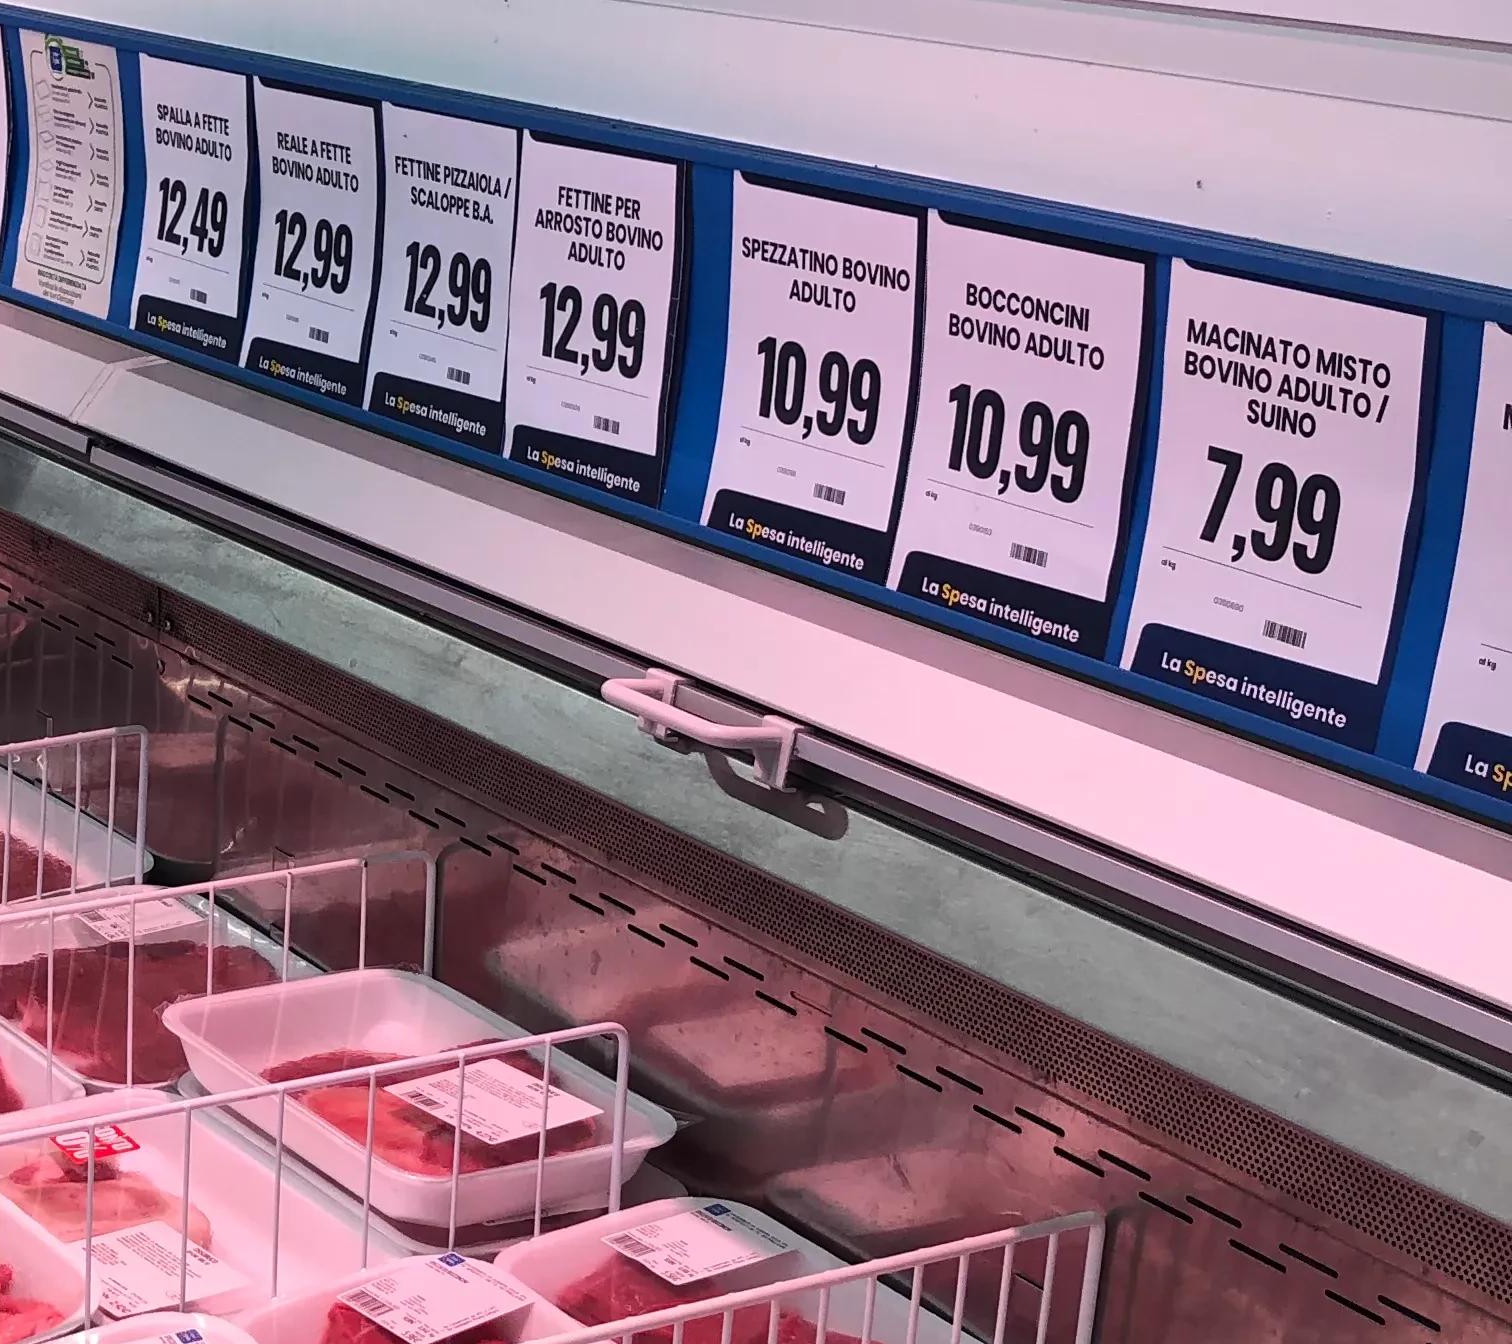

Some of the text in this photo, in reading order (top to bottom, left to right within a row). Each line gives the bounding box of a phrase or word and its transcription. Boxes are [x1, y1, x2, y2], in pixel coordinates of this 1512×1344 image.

[157, 104, 229, 136] SPALLA A FETTE
[156, 128, 232, 162] BOVINO ADULTO
[277, 132, 351, 164] REALE A FETTE
[272, 156, 358, 192] BOVINO ADULTO
[395, 156, 512, 199] FETTINE PIZZAIOLA /
[157, 177, 228, 258] 12,49
[410, 186, 494, 224] SCALOPPE B.A.
[558, 186, 641, 221] FETTINE PER
[274, 209, 353, 294] 12,99
[535, 209, 663, 252] ARROSTO BOVINO
[568, 242, 625, 271] ADULTO
[742, 236, 910, 292] SPEZZATINO BOVINO
[404, 241, 492, 333] 12,99
[789, 279, 856, 313] ADULTO
[966, 283, 1090, 332] BOCCONCINI
[147, 312, 227, 350] La Spesa intelligente
[540, 282, 646, 379] 12,99
[949, 313, 1105, 371] BOVINO ADULTO
[1187, 318, 1391, 389] MACINATO MISTO
[259, 356, 346, 396] La Spesa intelligente
[758, 336, 881, 446] 10,99
[1184, 350, 1390, 424] BOVINO ADULTO /
[385, 391, 487, 437] La Spesa intelligente
[1247, 399, 1316, 439] SUINO
[948, 384, 1089, 504] 10,99
[527, 446, 641, 493] La Spesa intelligente
[1199, 445, 1341, 575] 7,99
[729, 512, 864, 571] La Spesa intelligente
[922, 576, 1080, 644] La Spesa intelligente
[1161, 651, 1347, 729] La Spesa intelligente
[1465, 754, 1488, 777] La
